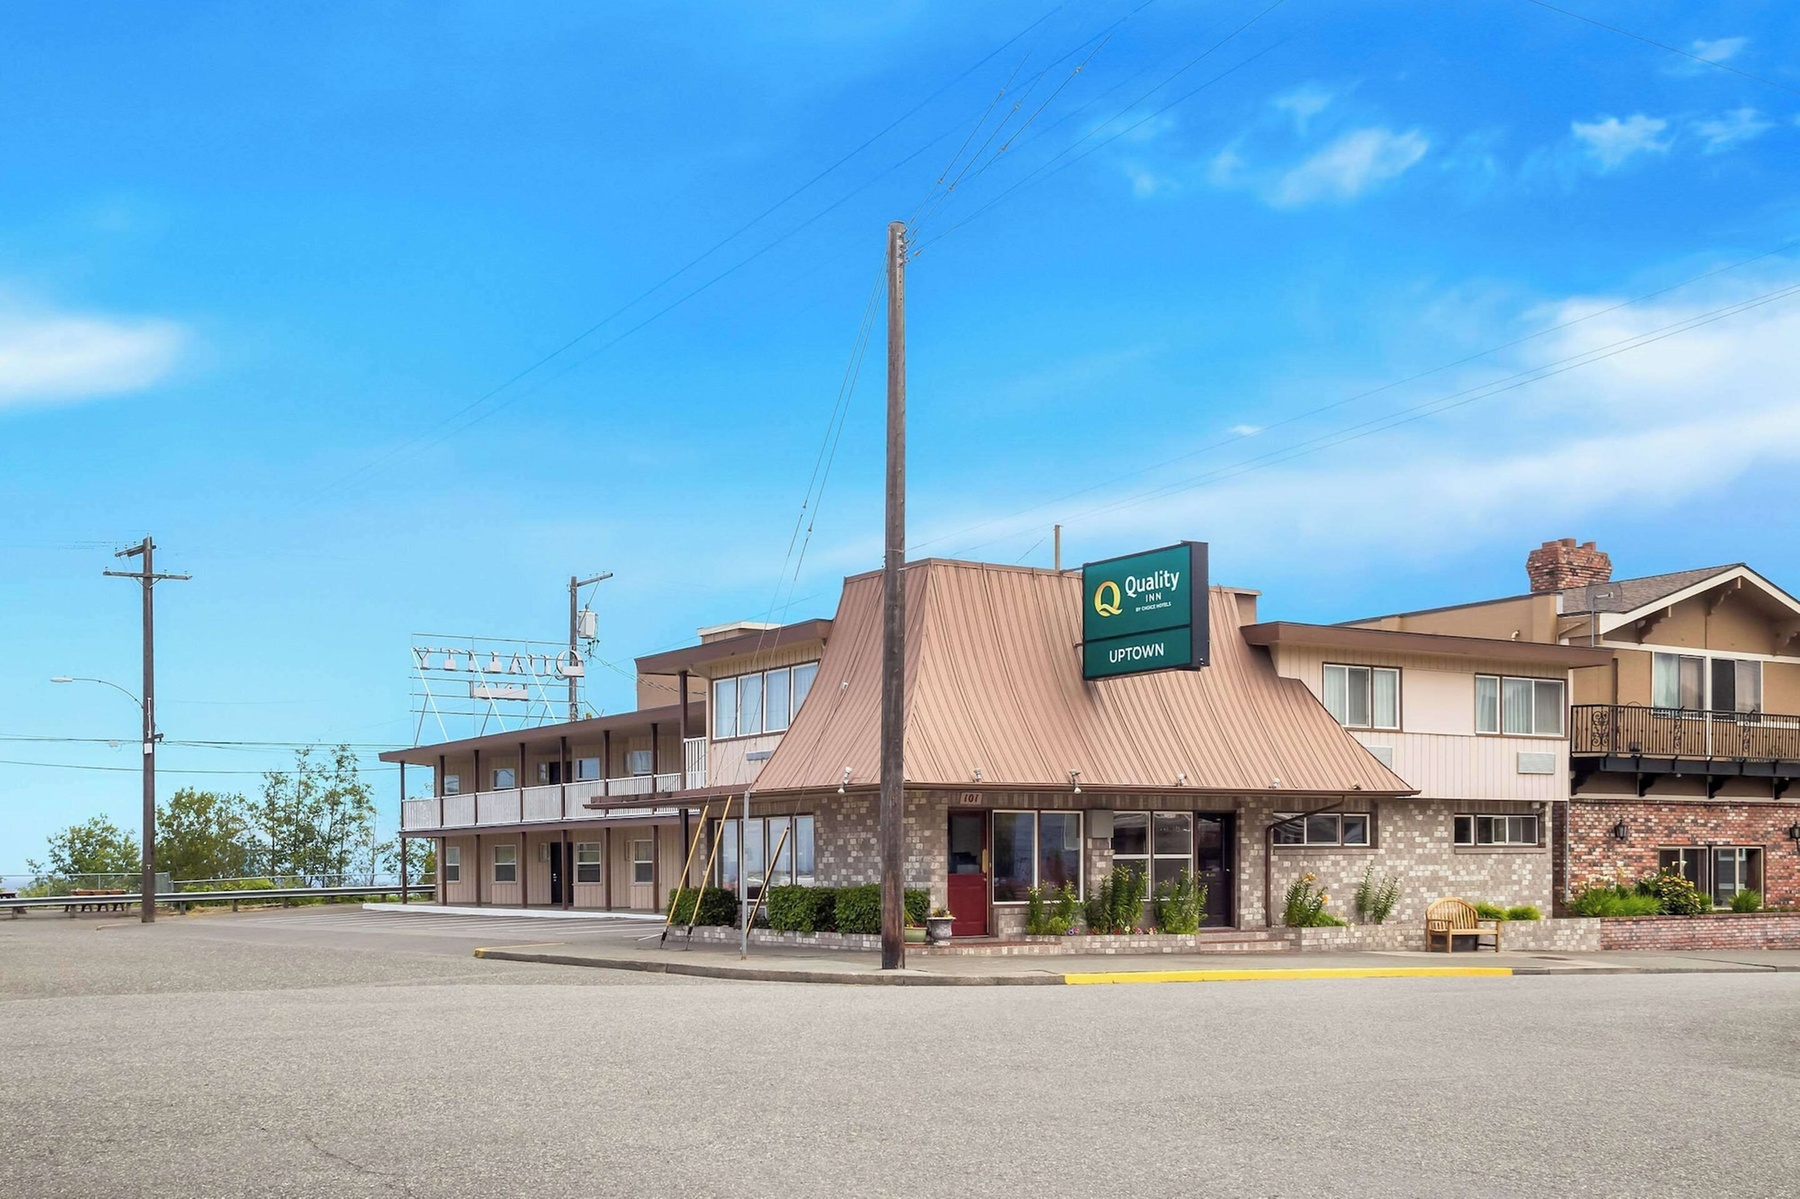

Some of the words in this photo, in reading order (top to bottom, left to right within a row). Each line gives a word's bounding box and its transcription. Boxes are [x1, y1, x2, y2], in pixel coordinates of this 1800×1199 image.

[1125, 570, 1180, 597] Quality
[1145, 592, 1162, 602] INN
[1141, 603, 1156, 612] CHOICE
[1156, 601, 1172, 610] HOTELS
[1109, 642, 1164, 663] UPTOWN
[964, 793, 979, 803] 101
